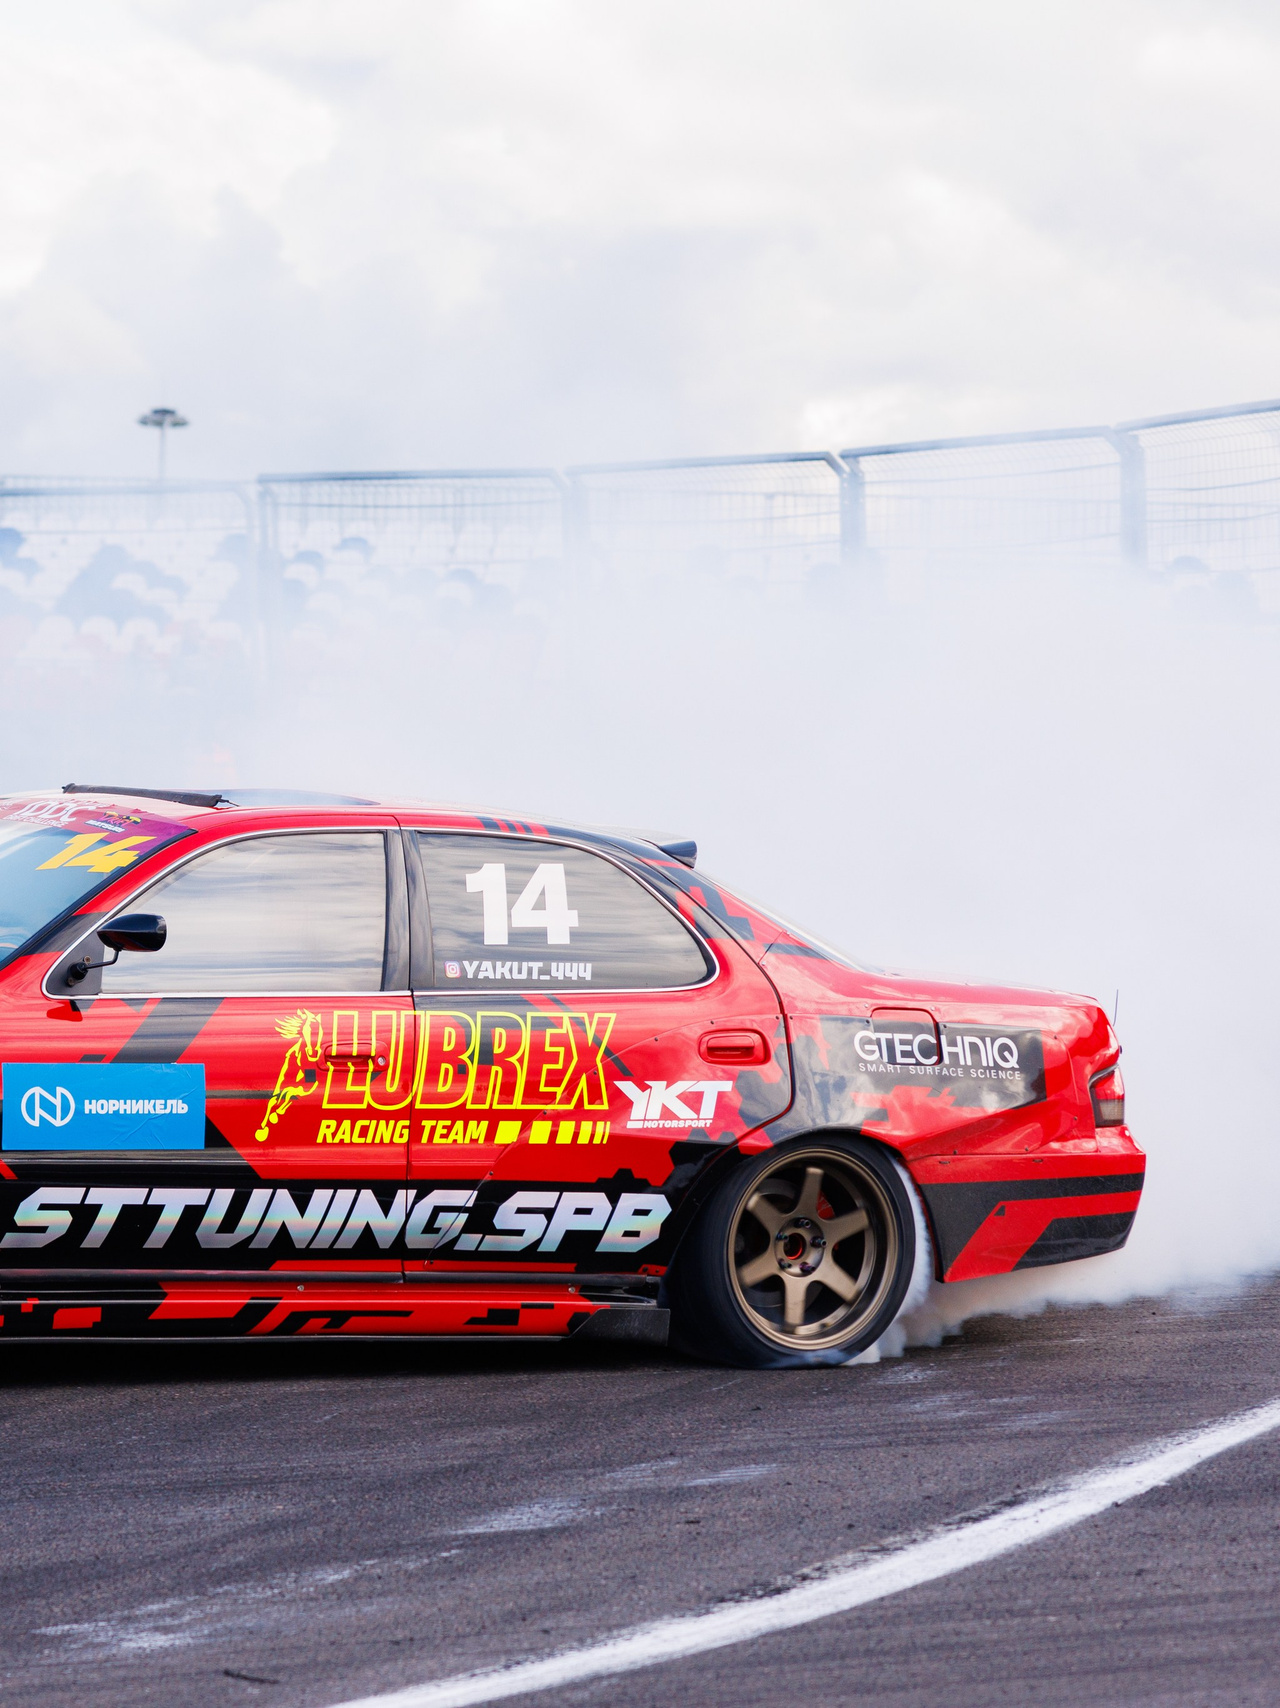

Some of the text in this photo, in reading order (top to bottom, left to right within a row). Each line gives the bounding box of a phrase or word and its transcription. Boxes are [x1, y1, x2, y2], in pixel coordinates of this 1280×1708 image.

[35, 832, 157, 873] 14
[465, 863, 579, 945] 14
[462, 960, 592, 981] YAKUT_444
[321, 1010, 617, 1110] LUBREX
[854, 1030, 1019, 1068] GTECHNIQ
[859, 1062, 1021, 1080] SMART SURFACE SCIENCE
[84, 1099, 189, 1115] НОРНИКЕЛЬ
[613, 1081, 733, 1120] YKT
[317, 1120, 486, 1144] RACING TEAM
[643, 1119, 712, 1128] MOTORSPORT
